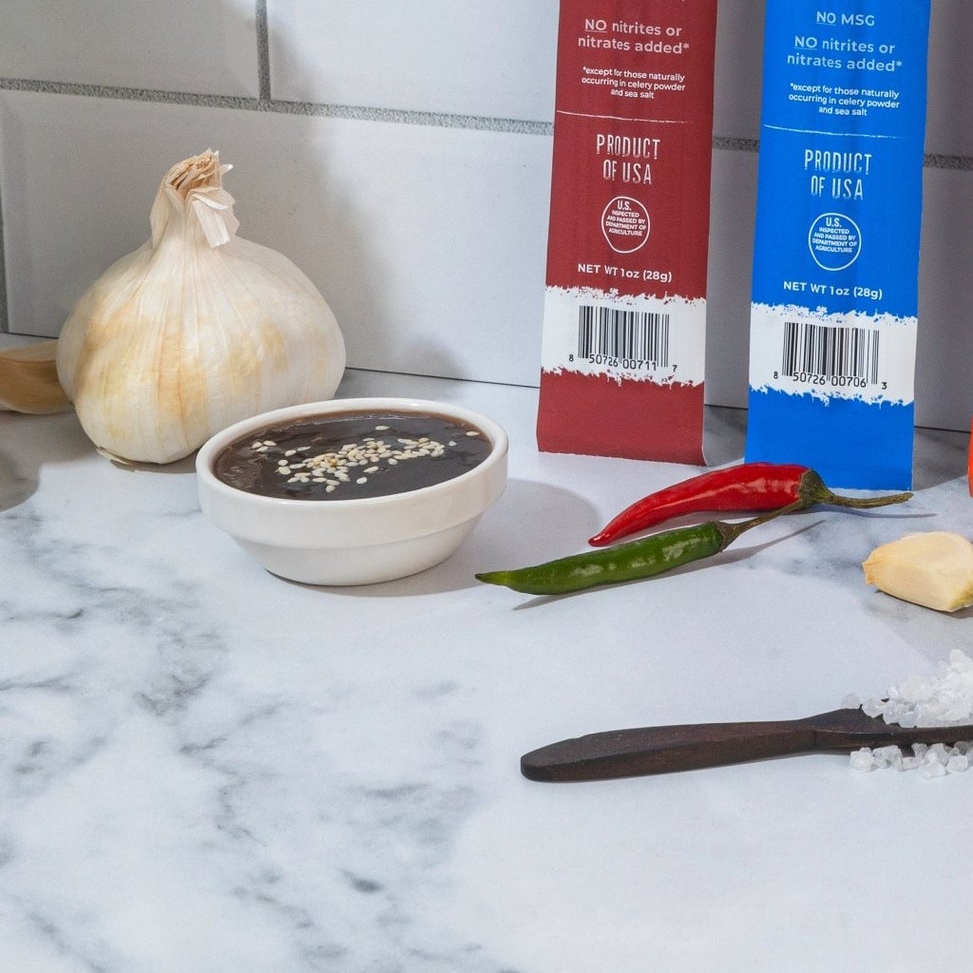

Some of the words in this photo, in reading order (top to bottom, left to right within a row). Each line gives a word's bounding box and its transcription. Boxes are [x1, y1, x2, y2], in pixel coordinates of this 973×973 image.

[585, 19, 607, 33] NO
[612, 21, 661, 36] nitrites
[666, 27, 682, 37] or
[816, 11, 837, 26] NO
[841, 14, 875, 27] MSG
[578, 35, 630, 51] nitrates
[794, 36, 818, 50] NO
[822, 38, 874, 53] nitrites
[879, 44, 895, 54] or
[787, 53, 842, 68] nitrates
[788, 94, 827, 105] occurring
[828, 97, 837, 105] in
[839, 98, 866, 107] celery
[867, 99, 900, 108] powder
[822, 85, 832, 94] for
[834, 87, 859, 96] those
[861, 89, 899, 99] naturally
[596, 134, 660, 160] PRODUCT
[804, 149, 872, 175] PRODUCT
[603, 159, 617, 181] OF
[622, 162, 652, 185] USA
[811, 175, 825, 197] OF
[832, 178, 863, 200] USA
[826, 217, 842, 227] U.S.
[578, 263, 601, 274] NET
[604, 265, 618, 275] WT
[643, 270, 672, 283] (28g)
[783, 281, 807, 292] NET
[811, 284, 826, 294] WT
[853, 287, 883, 300] (28g)
[569, 354, 573, 362] 8
[589, 354, 618, 367] 50726
[622, 359, 657, 371] 00711
[773, 371, 778, 379] 8
[793, 372, 825, 386] 50726
[831, 376, 866, 388] 00706
[882, 382, 887, 390] 3
